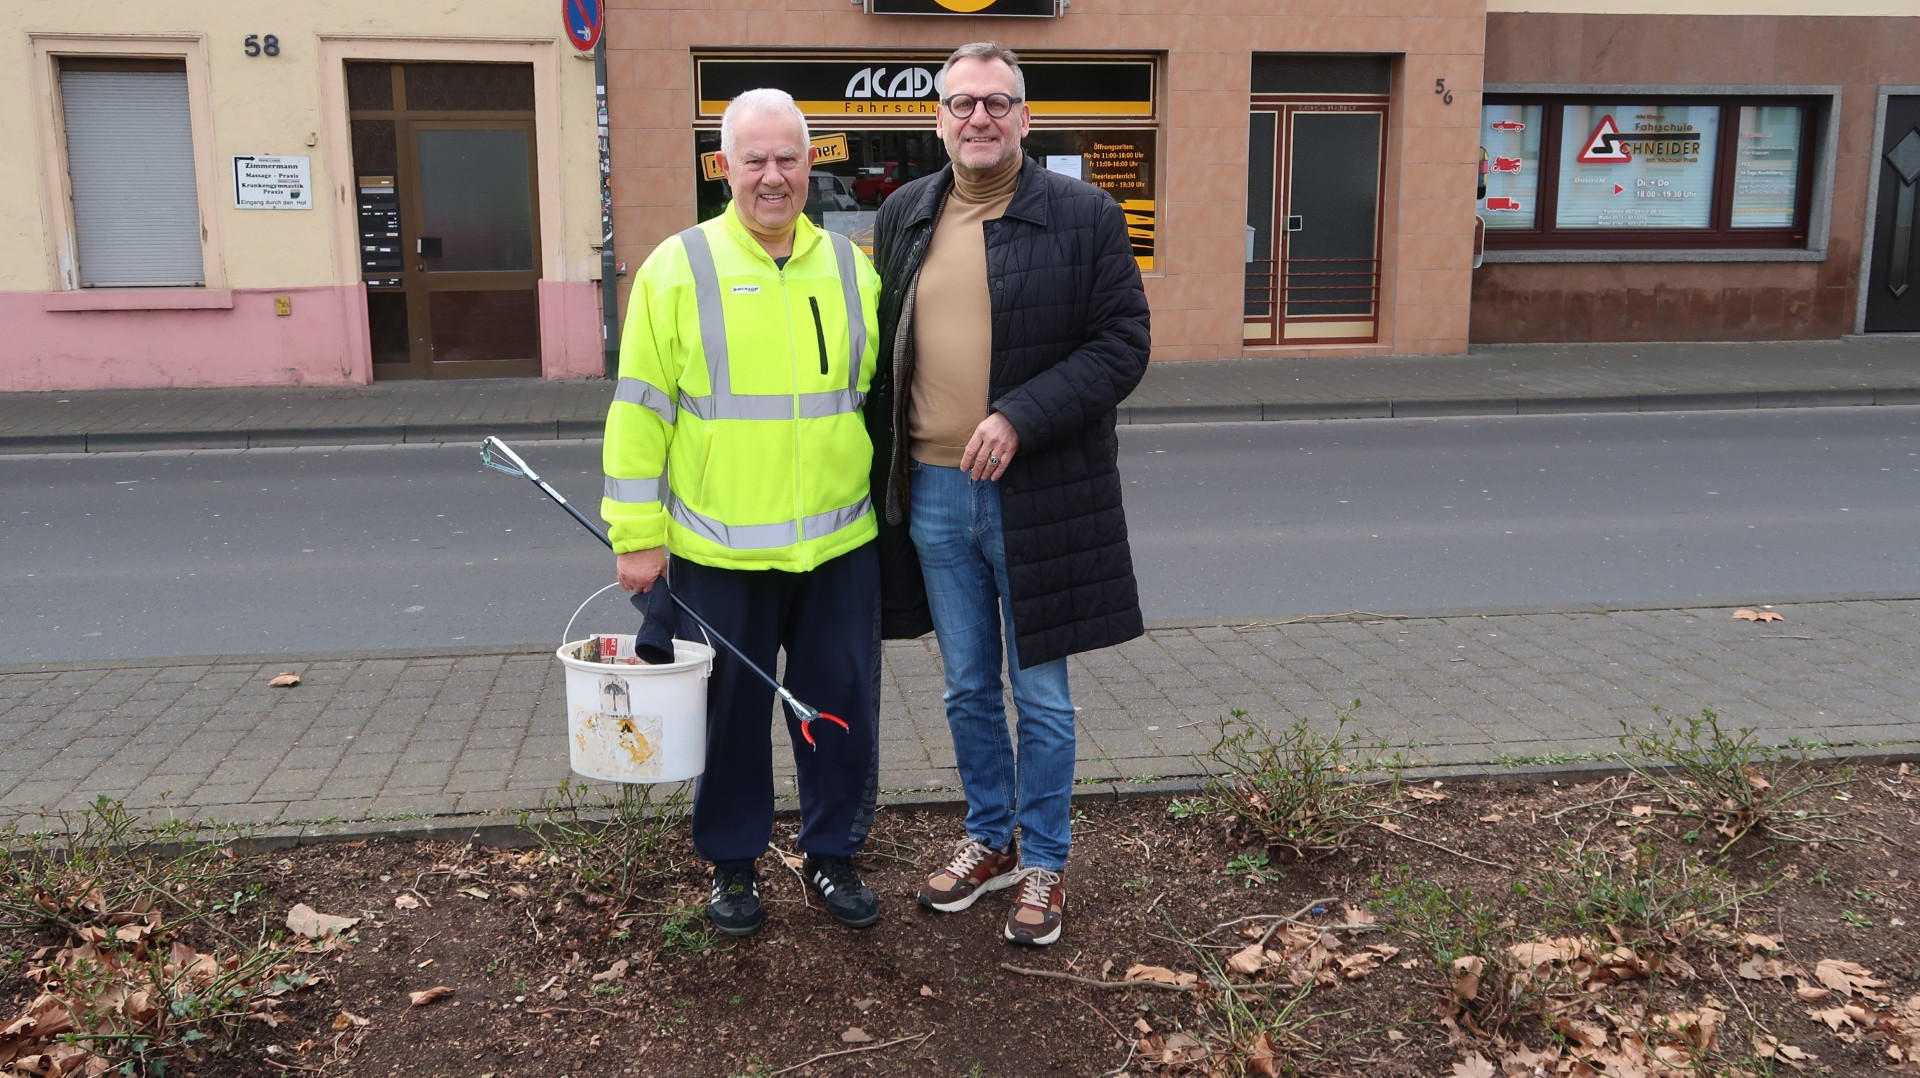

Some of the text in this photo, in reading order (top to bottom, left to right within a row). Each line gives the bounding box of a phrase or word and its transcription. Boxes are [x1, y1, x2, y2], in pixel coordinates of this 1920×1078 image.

[244, 34, 280, 57] 58
[1635, 123, 1693, 131] Fahrschule
[1093, 142, 1134, 151] Öffnungszeiten:
[1637, 179, 1647, 187] Di.
